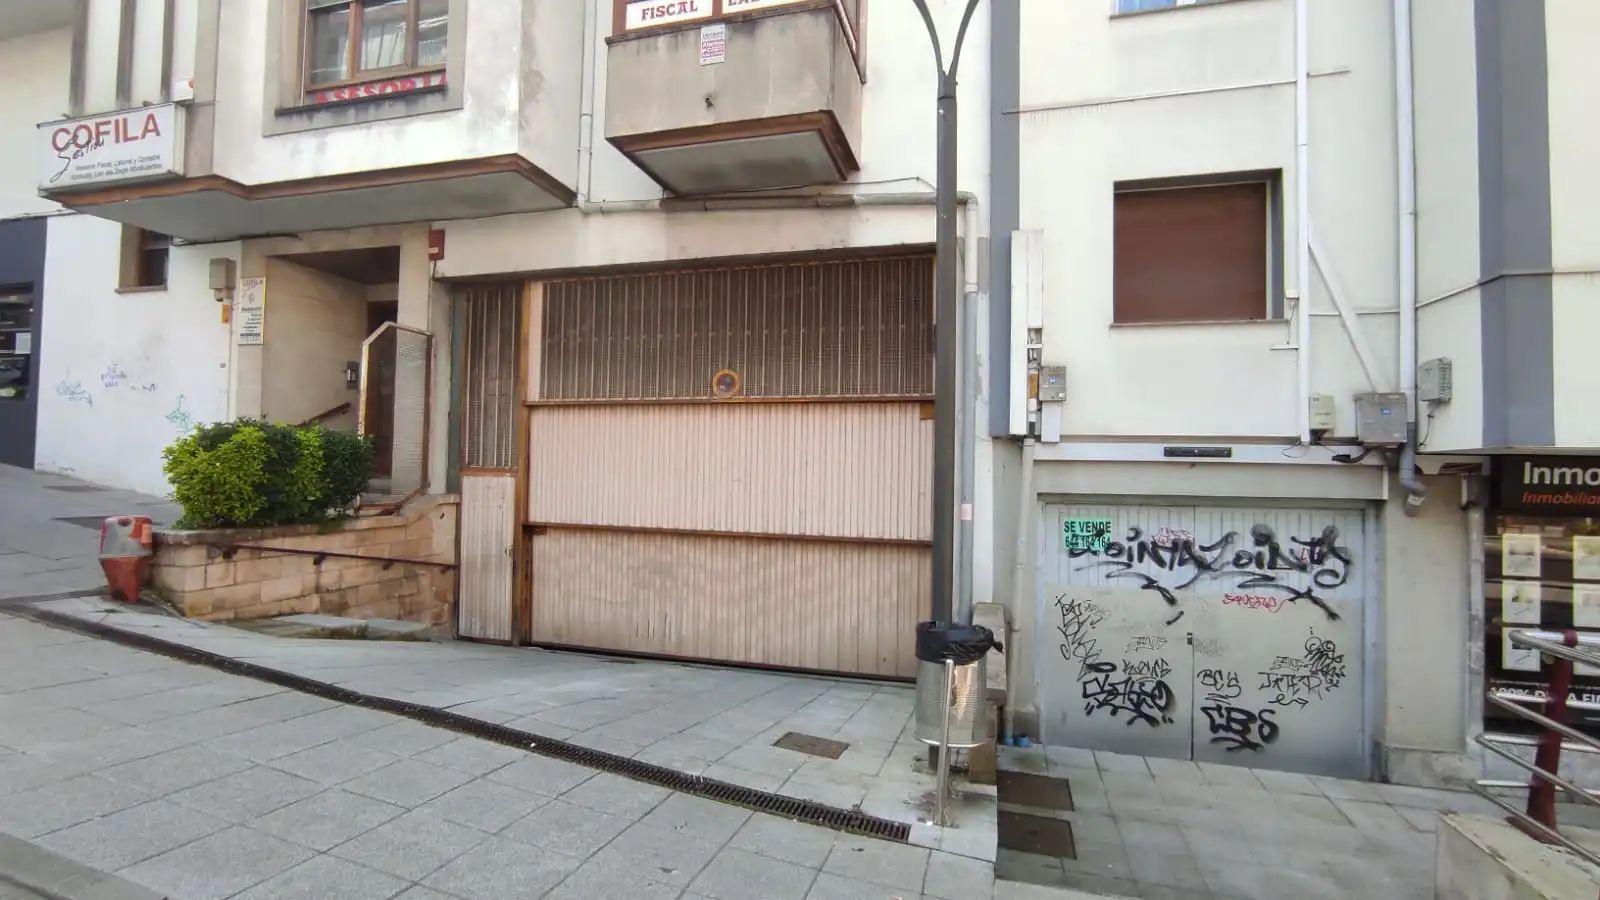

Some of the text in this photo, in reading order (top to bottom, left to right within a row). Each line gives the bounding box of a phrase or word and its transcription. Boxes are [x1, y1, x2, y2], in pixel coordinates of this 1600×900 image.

[641, 1, 698, 21] FISCAL
[52, 112, 161, 153] COFILA
[1523, 461, 1600, 487] Inmo
[1064, 520, 1112, 534] SE VENDE
